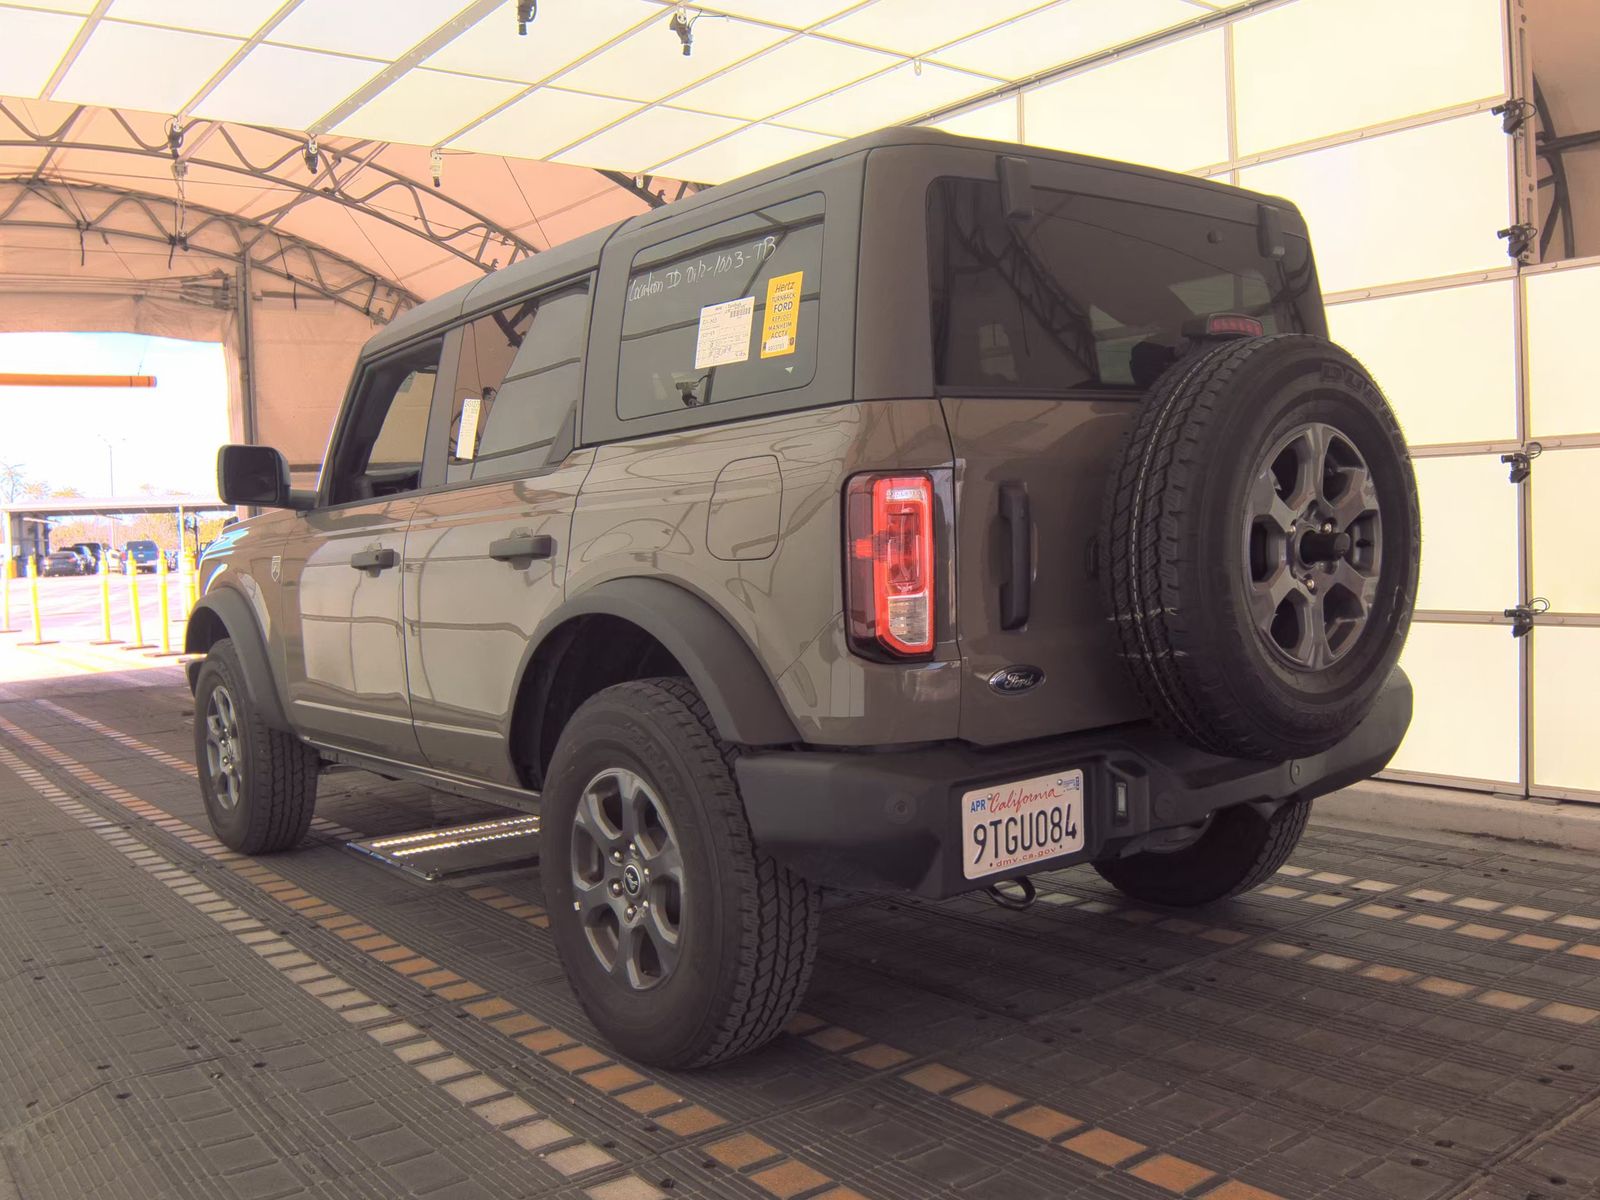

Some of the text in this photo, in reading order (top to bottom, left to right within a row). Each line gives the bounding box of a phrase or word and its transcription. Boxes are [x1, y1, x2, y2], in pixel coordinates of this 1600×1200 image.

[773, 301, 793, 313] FORD
[970, 785, 1062, 814] APR California
[973, 803, 1077, 865] 9TGU084
[996, 847, 1057, 868] dmv.ca.gov
